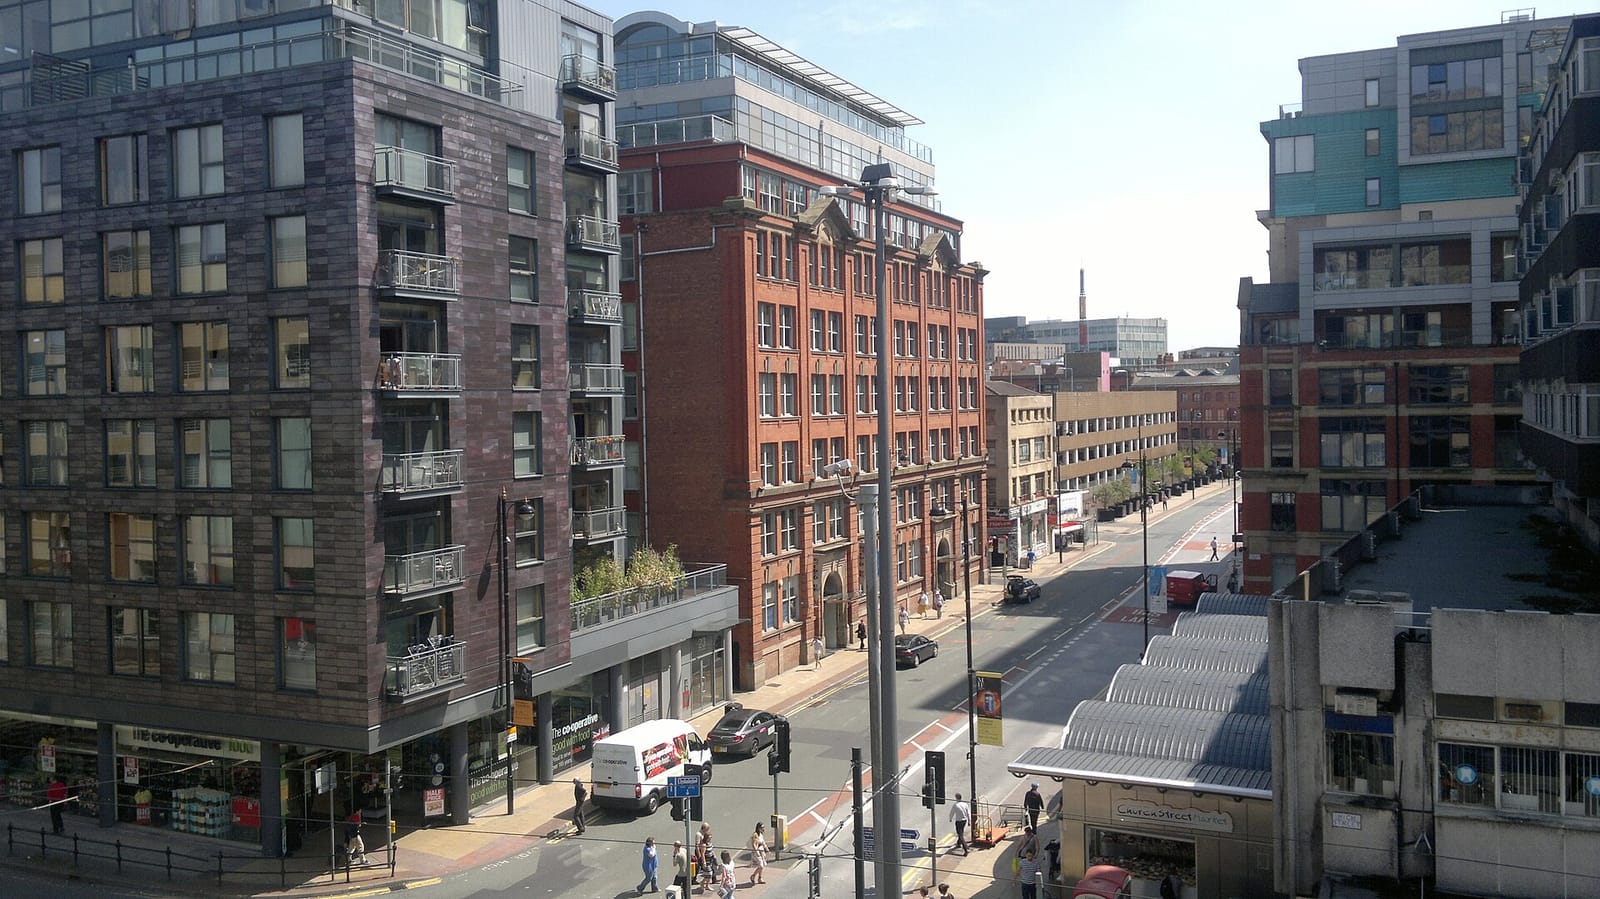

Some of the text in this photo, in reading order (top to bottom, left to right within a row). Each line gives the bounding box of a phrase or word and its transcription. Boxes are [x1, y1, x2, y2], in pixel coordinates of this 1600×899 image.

[551, 713, 599, 738] The co-operative
[552, 738, 566, 754] good
[577, 727, 591, 743] food
